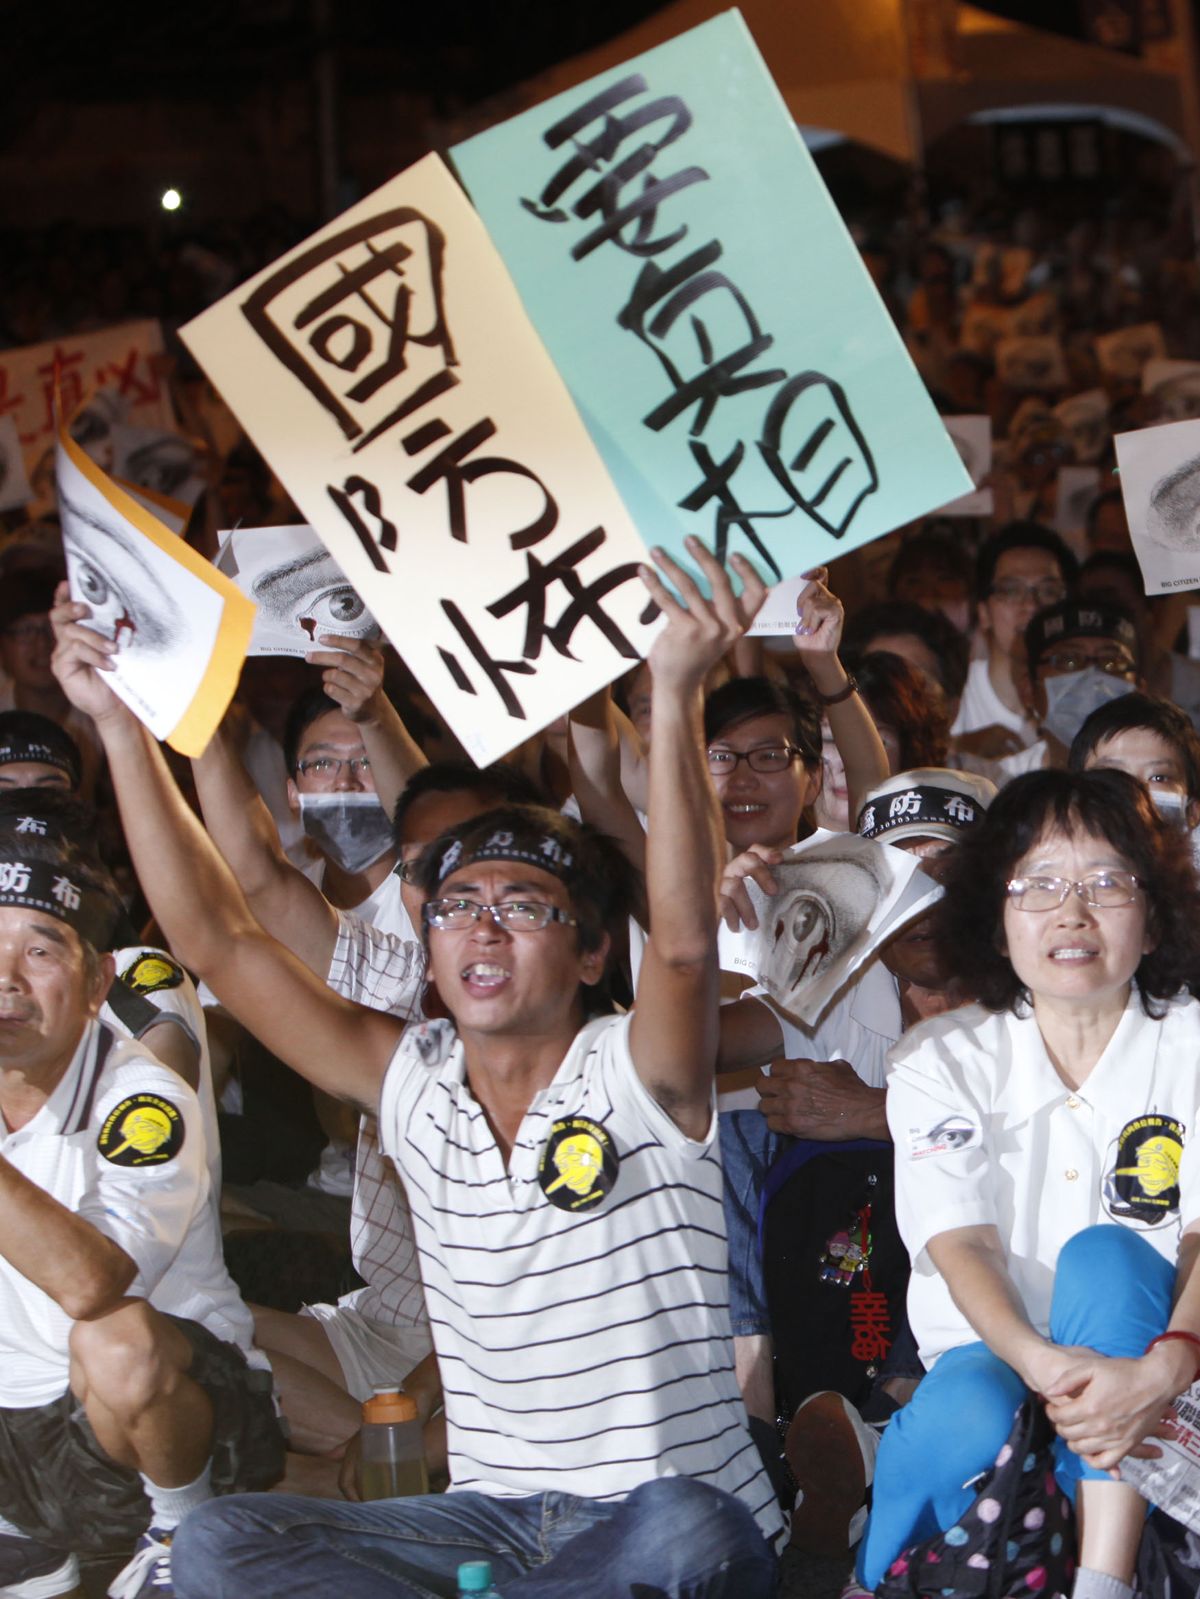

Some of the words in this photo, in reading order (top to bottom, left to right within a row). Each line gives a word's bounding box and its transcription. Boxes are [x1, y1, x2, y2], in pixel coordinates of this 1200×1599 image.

[520, 74, 879, 583] 要真相
[1173, 578, 1199, 587] CITIZEN
